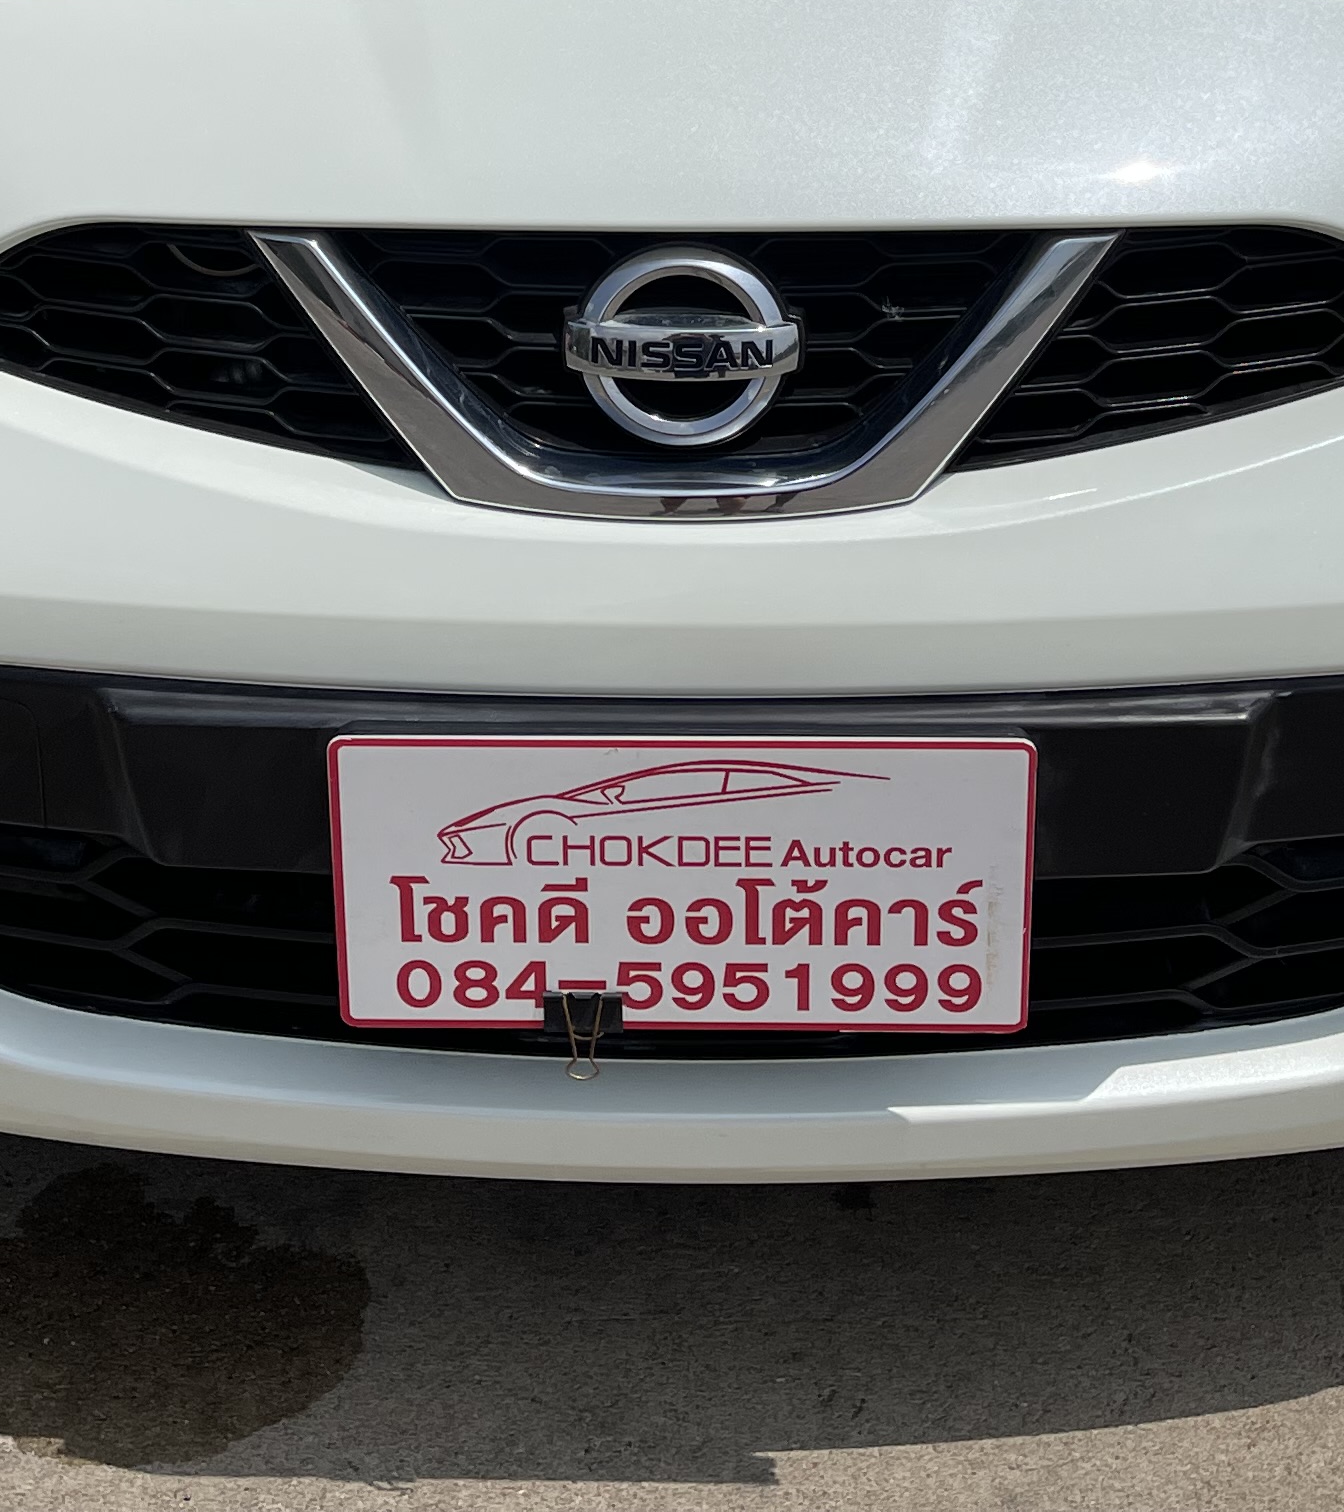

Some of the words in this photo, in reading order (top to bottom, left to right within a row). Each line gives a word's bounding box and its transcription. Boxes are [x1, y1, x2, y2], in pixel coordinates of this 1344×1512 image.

[591, 336, 773, 371] NISSAN
[526, 835, 773, 867] CHOKDEE
[780, 838, 953, 868] Autocar
[389, 875, 590, 944] โชคดี
[626, 878, 984, 947] ออโต้คาร์
[396, 960, 983, 1013] 084-5951999
